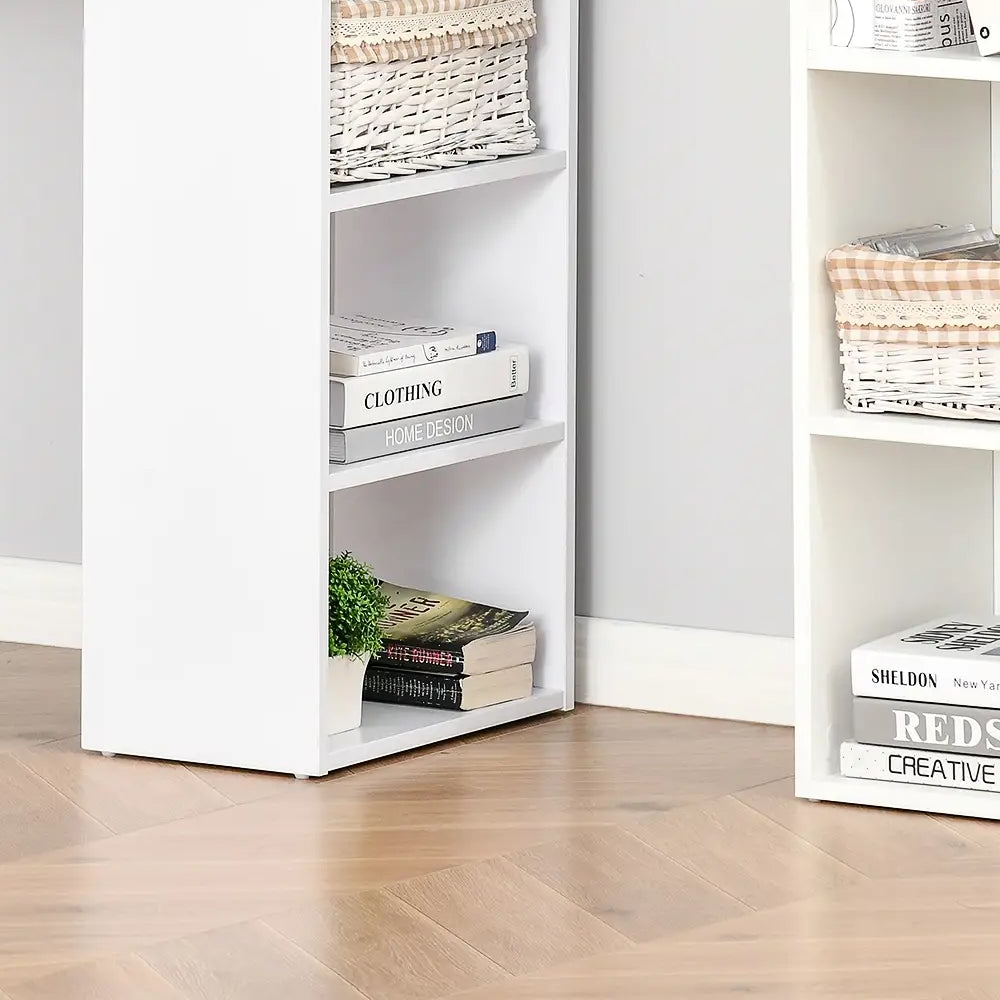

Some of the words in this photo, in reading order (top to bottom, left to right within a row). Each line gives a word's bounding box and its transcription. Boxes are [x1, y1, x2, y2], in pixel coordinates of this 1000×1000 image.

[364, 379, 443, 410] CLOTHING
[385, 423, 424, 447] HOME
[411, 648, 453, 668] RUNNER
[871, 668, 937, 688] SHELDON
[953, 677, 978, 689] New
[888, 754, 996, 785] CREATIVE
